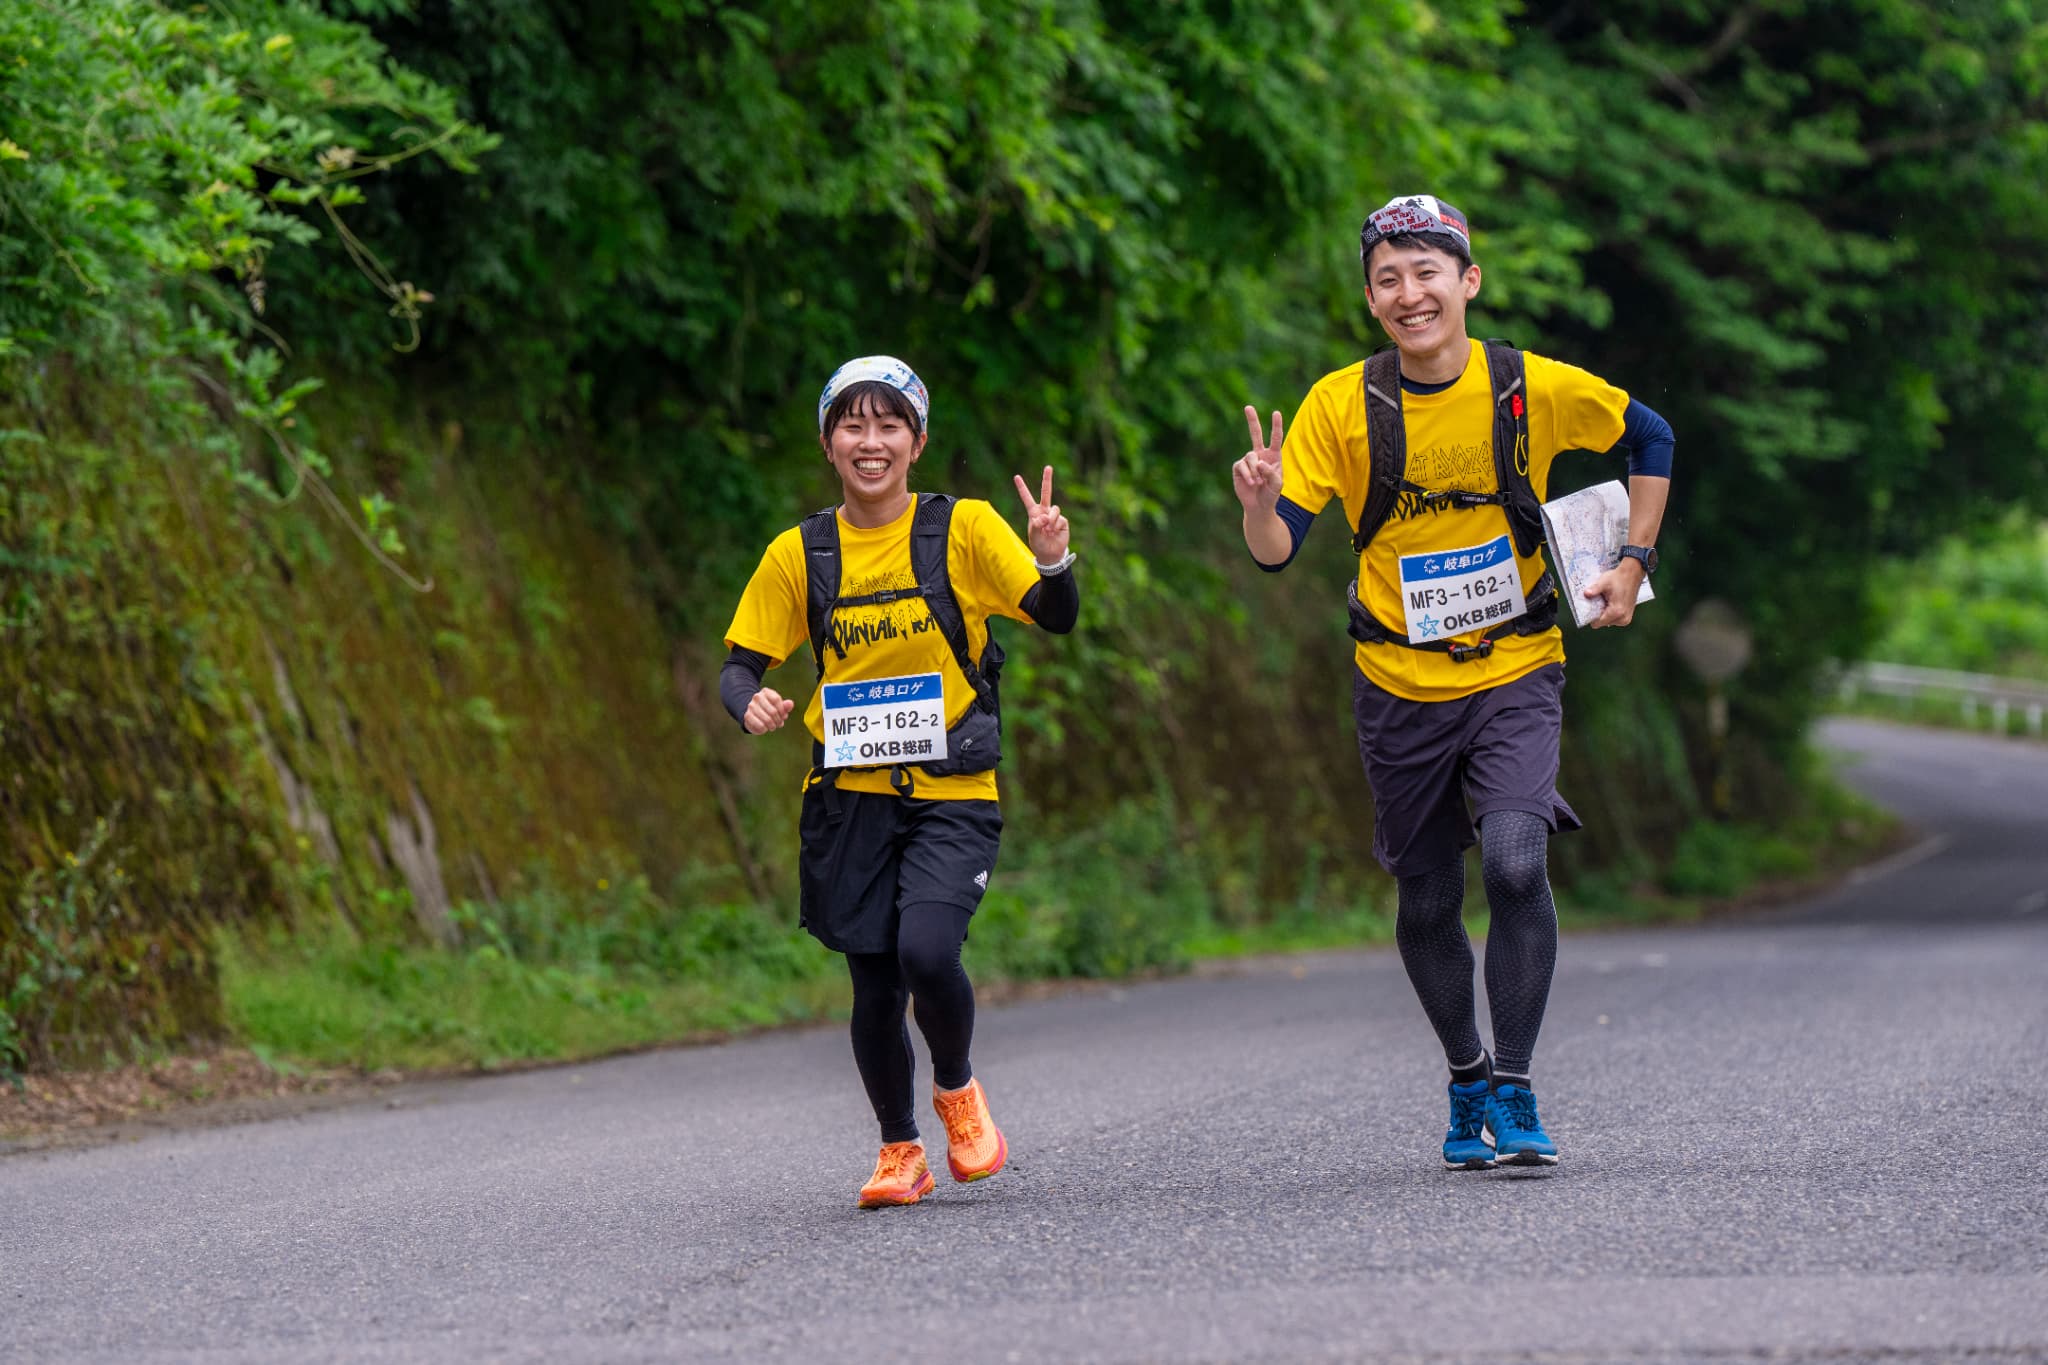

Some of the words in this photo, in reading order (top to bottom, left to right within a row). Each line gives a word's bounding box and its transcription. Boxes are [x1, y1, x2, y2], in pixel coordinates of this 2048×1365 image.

[1443, 545, 1498, 571] 岐阜ロゲ
[1410, 573, 1514, 610] MF3-162-1
[1443, 599, 1513, 631] OKB総研
[868, 681, 925, 700] 岐阜ロゲ
[832, 710, 939, 737] MF3-162-2
[860, 739, 933, 758] OKB総研
